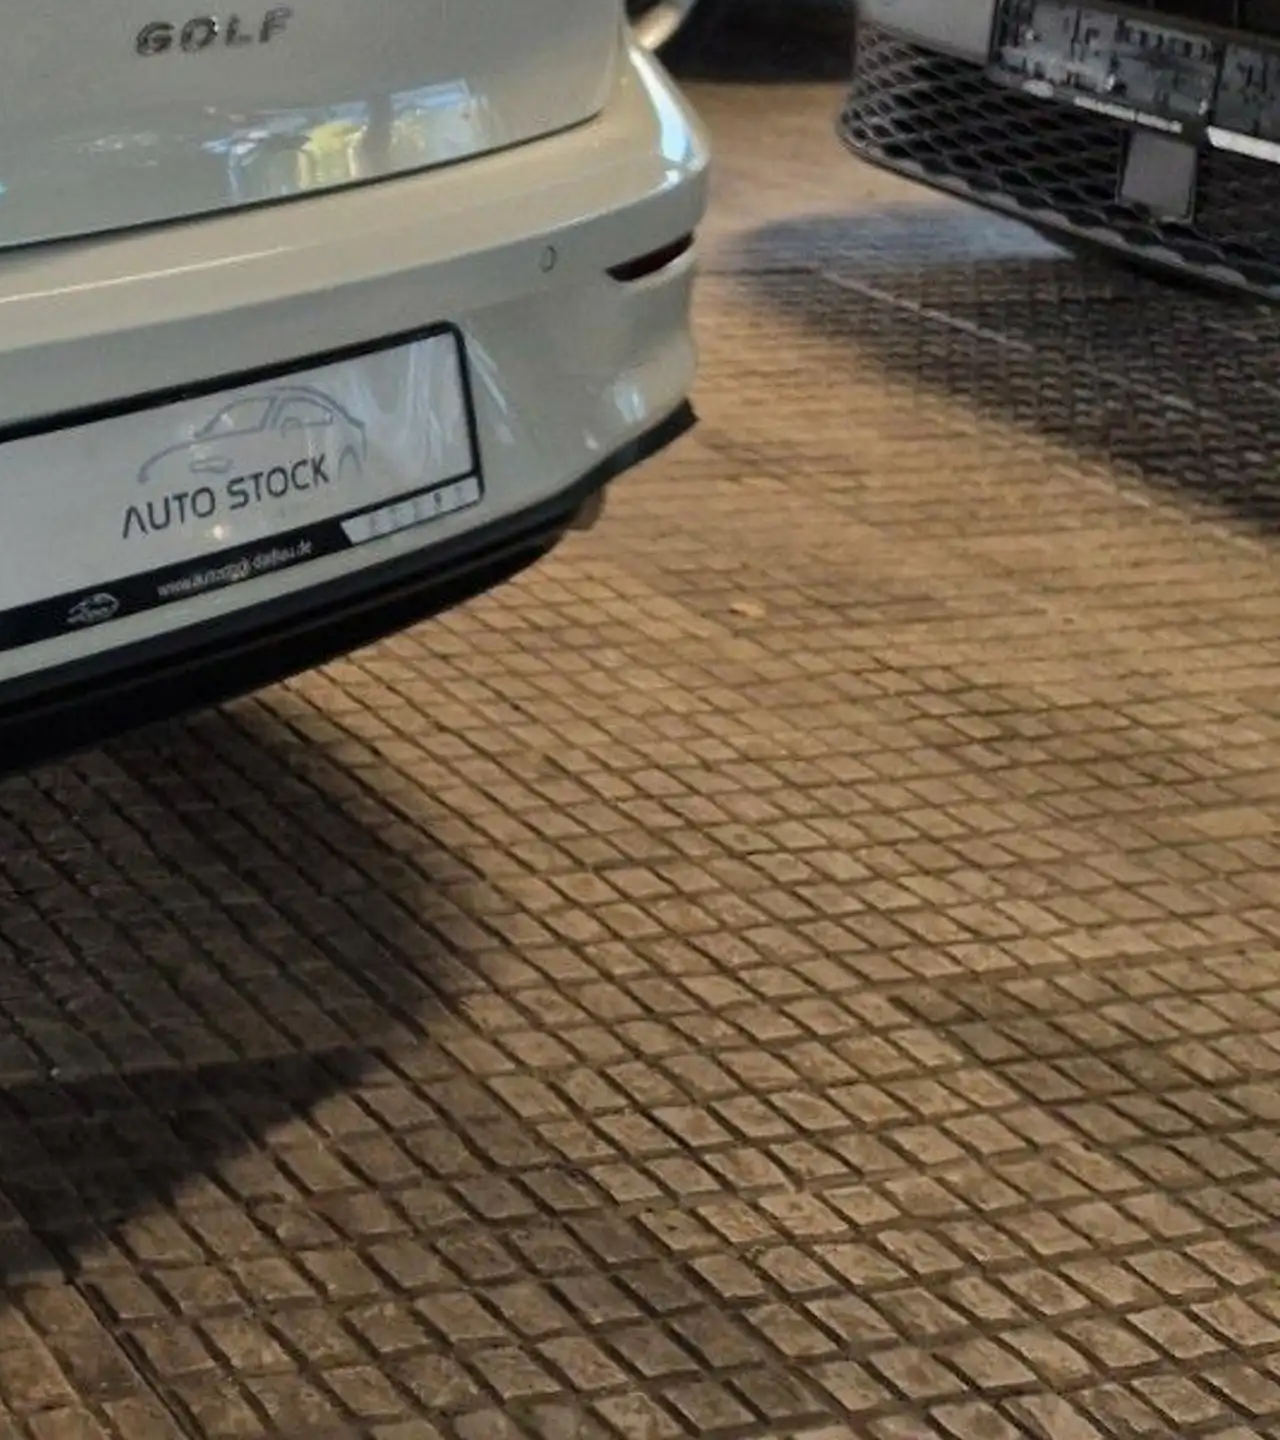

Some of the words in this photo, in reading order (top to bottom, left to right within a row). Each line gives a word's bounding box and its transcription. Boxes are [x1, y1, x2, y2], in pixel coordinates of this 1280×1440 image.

[135, 7, 292, 57] GOLF
[122, 486, 216, 540] AUTO
[226, 453, 330, 511] STOCK
